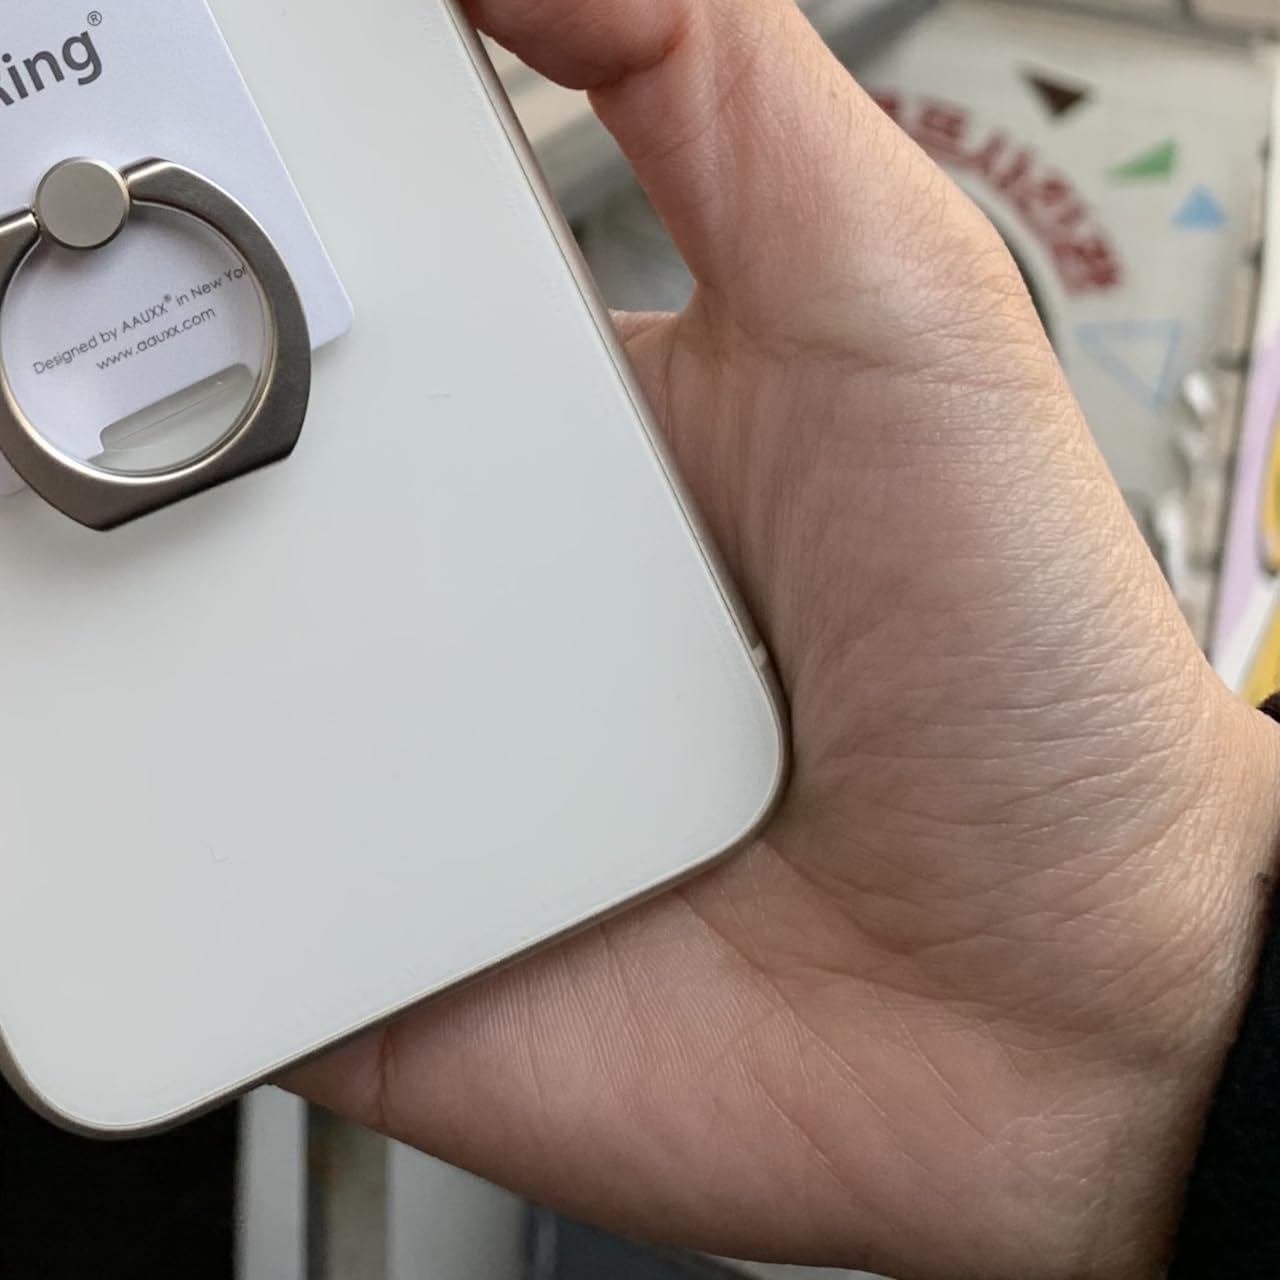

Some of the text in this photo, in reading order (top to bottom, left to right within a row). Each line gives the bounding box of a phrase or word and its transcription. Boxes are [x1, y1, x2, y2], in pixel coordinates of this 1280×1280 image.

[32, 336, 98, 374] Designed
[100, 327, 117, 343] by
[176, 292, 189, 306] in
[190, 277, 222, 299] New
[96, 306, 216, 370] www.aauxx.com
